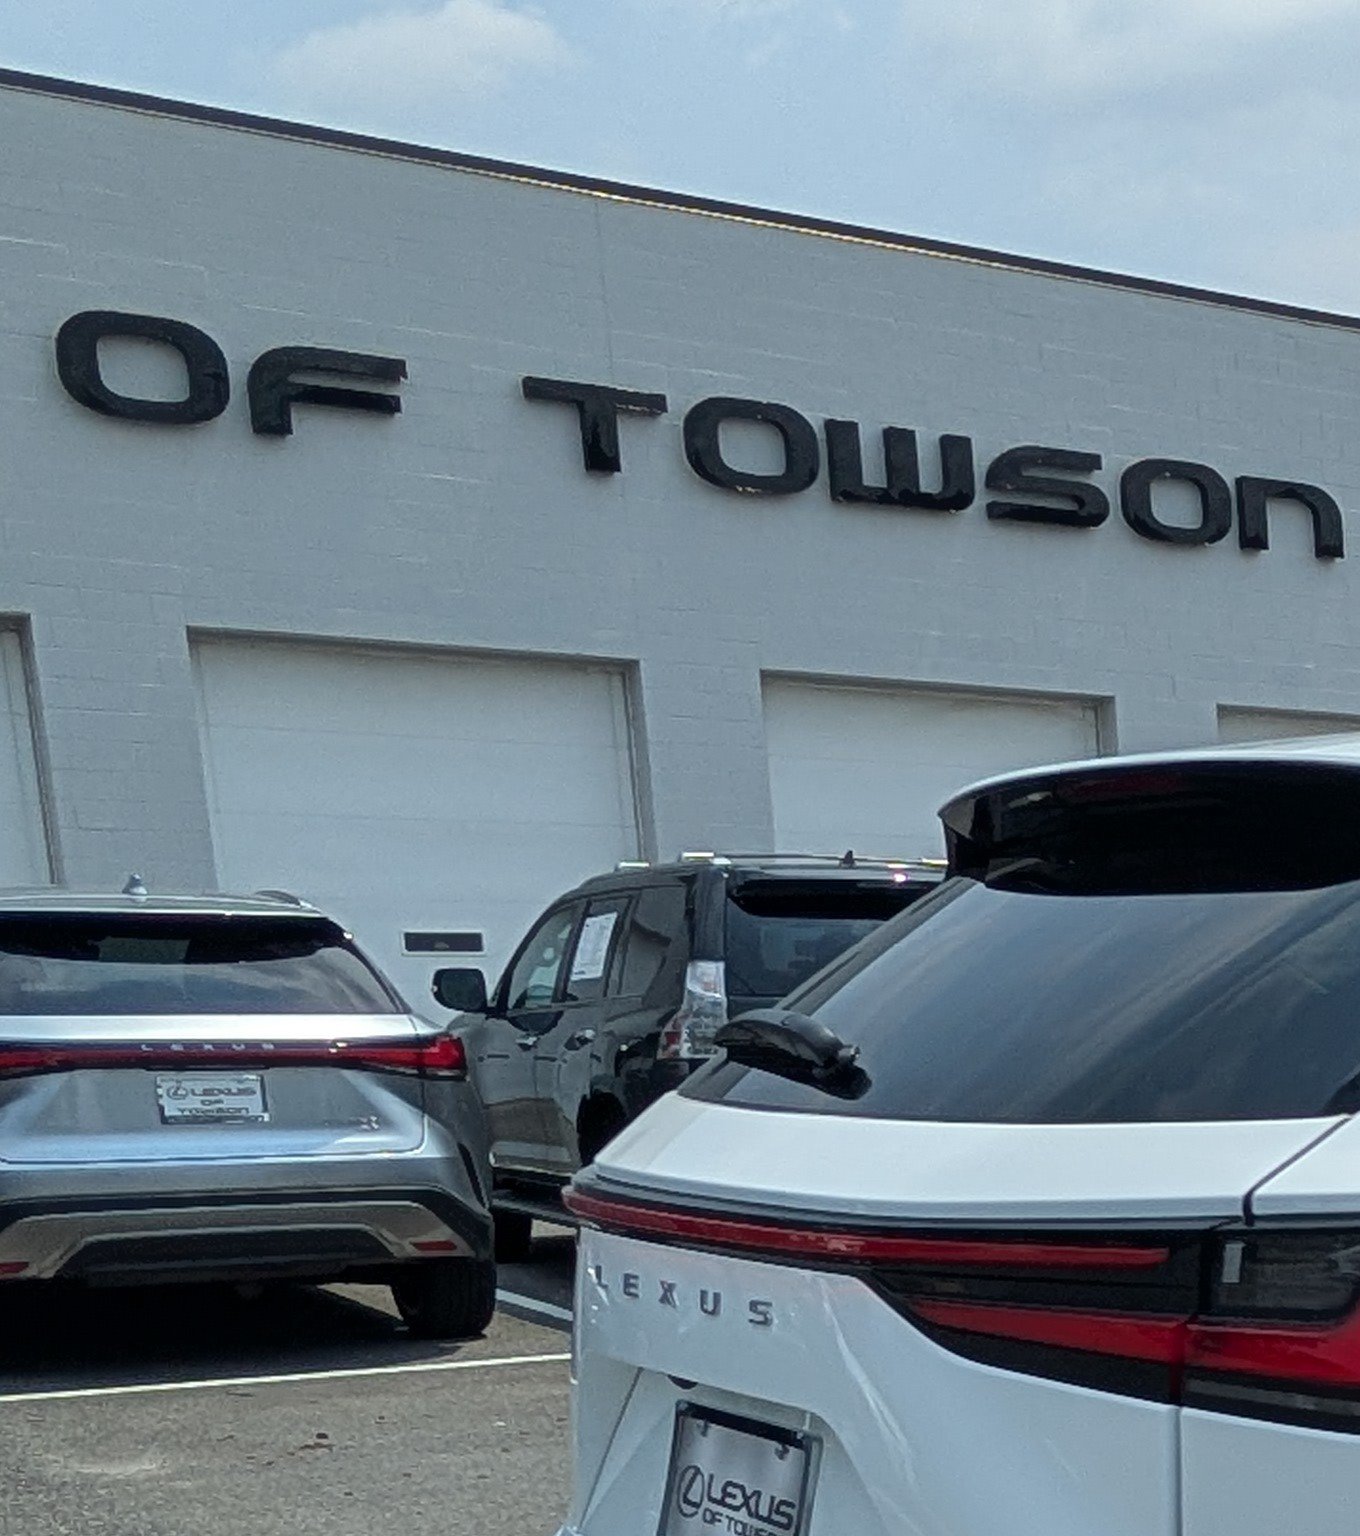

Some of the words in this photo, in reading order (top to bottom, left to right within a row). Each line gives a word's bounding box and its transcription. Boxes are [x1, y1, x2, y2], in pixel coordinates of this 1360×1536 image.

[54, 309, 407, 436] OF
[592, 1264, 776, 1327] LEXUS
[701, 1507, 723, 1527] OF
[705, 1472, 797, 1532] LEXUS
